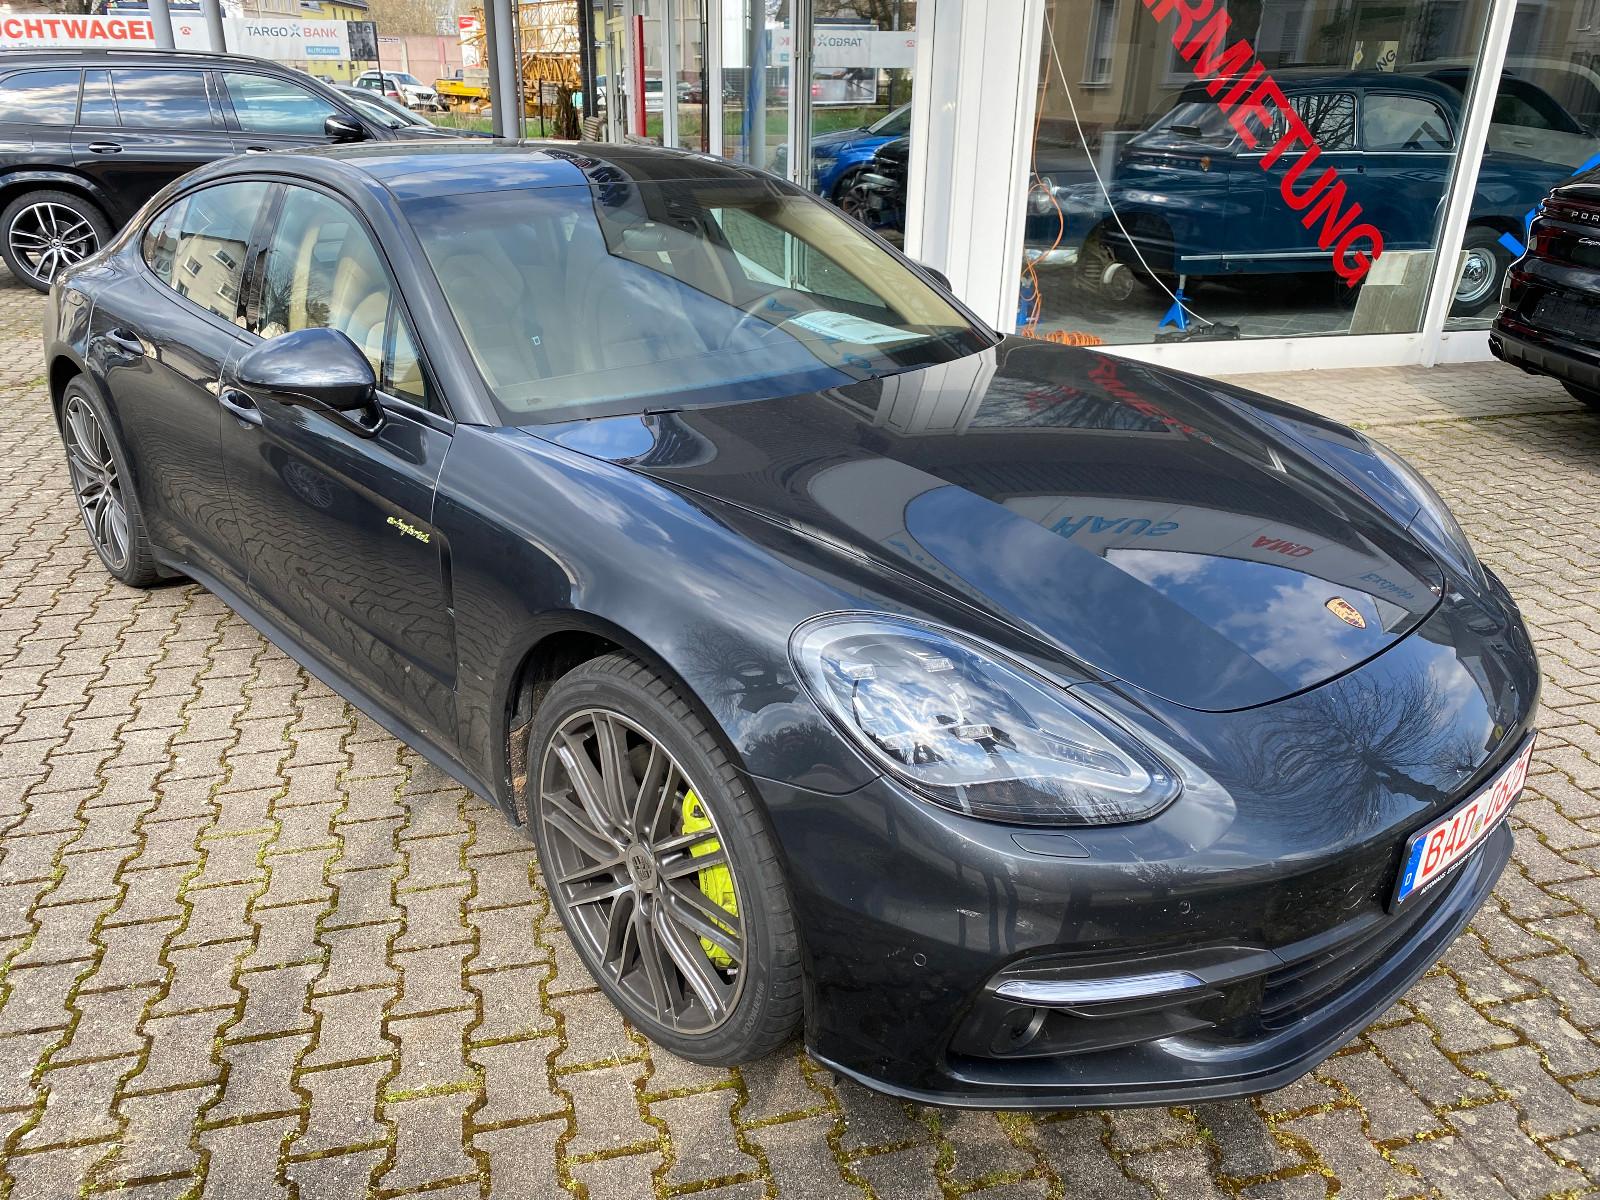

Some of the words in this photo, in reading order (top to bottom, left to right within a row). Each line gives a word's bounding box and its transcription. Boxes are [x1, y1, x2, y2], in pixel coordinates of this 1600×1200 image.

[0, 18, 156, 40] CHTWAGE
[246, 26, 288, 37] TARGO
[303, 27, 337, 38] BANK
[1142, 0, 1384, 288] RMIETUNG
[1422, 804, 1478, 878] BAD
[1404, 872, 1413, 887] D
